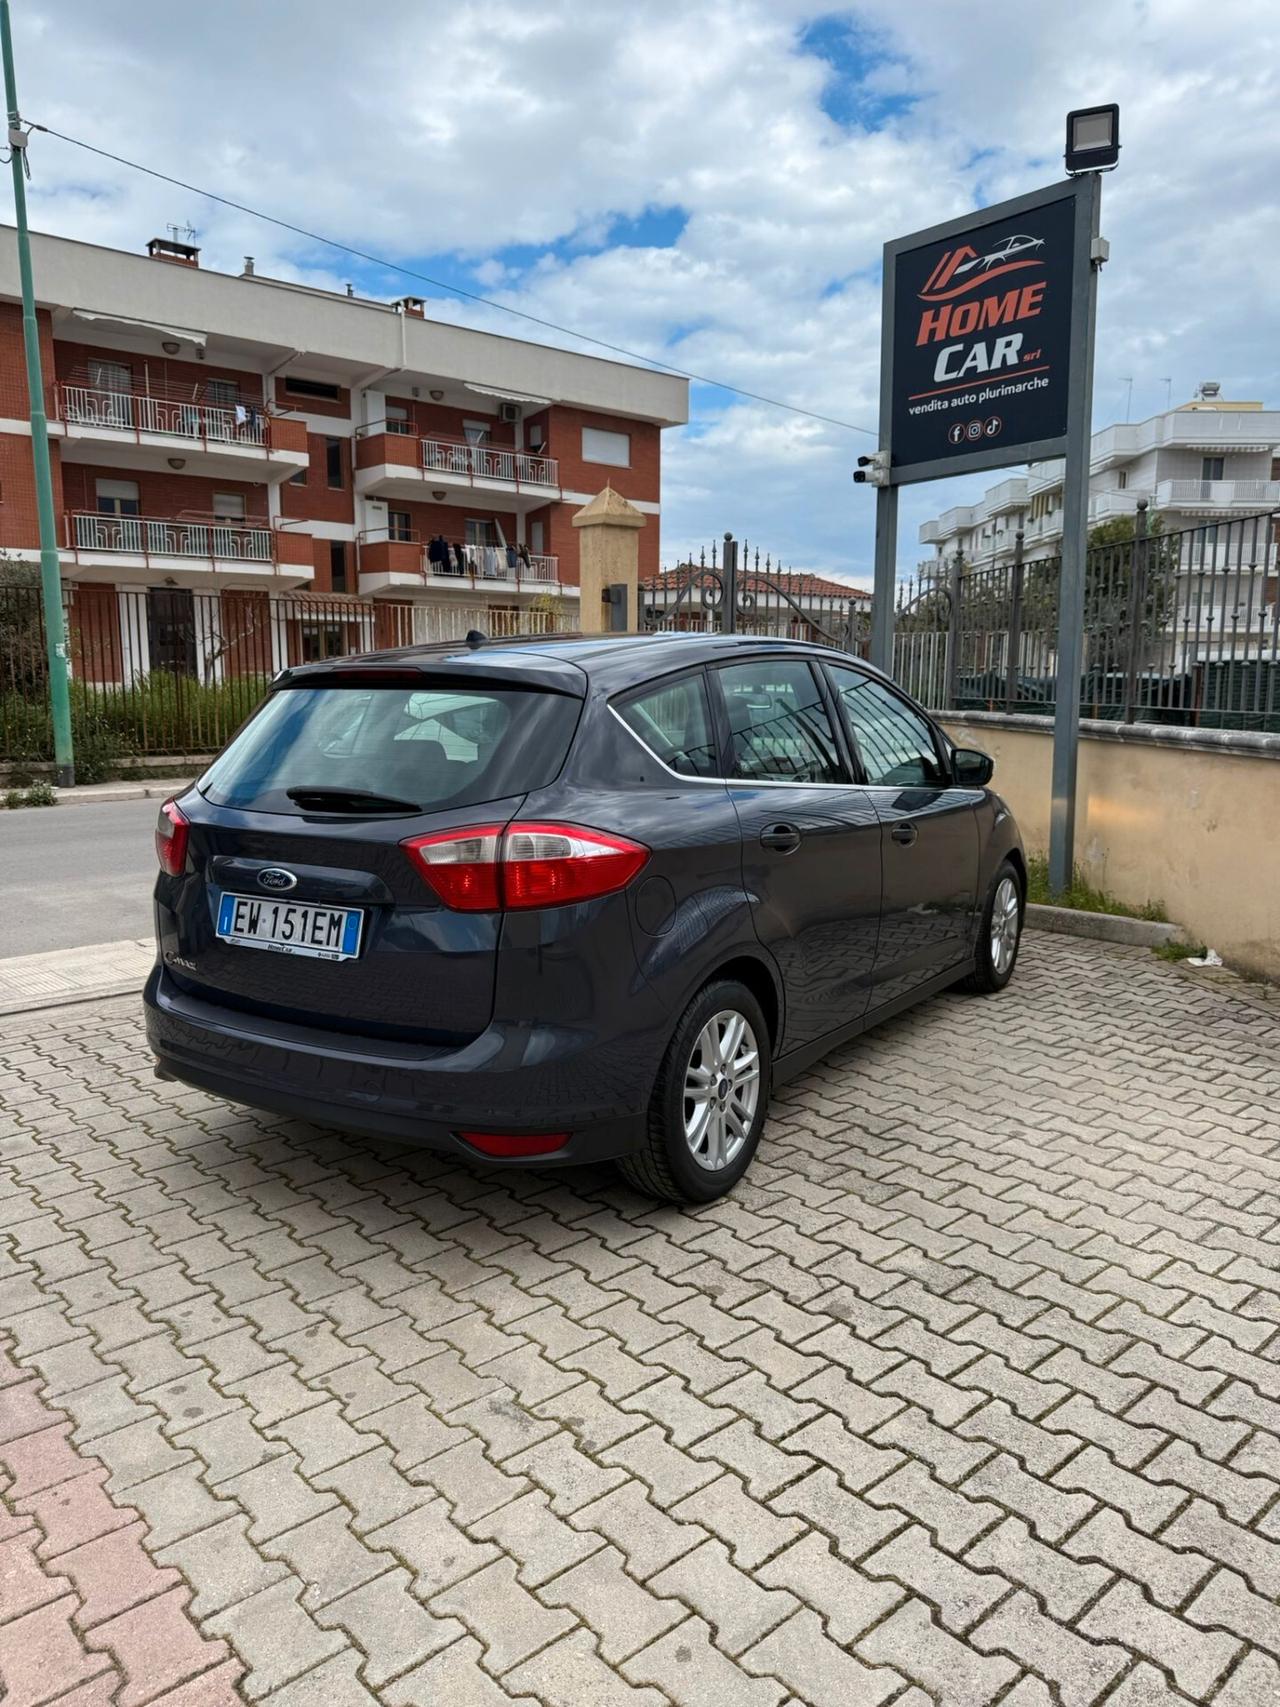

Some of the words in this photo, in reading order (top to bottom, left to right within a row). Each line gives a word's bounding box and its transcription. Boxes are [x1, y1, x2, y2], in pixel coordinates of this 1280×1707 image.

[917, 282, 1046, 345] HOME
[934, 333, 1024, 382] CAR
[1023, 349, 1041, 362] srl
[909, 399, 949, 416] vendita
[951, 394, 976, 408] auto
[978, 377, 1049, 404] plurimarche
[263, 872, 286, 886] Ford
